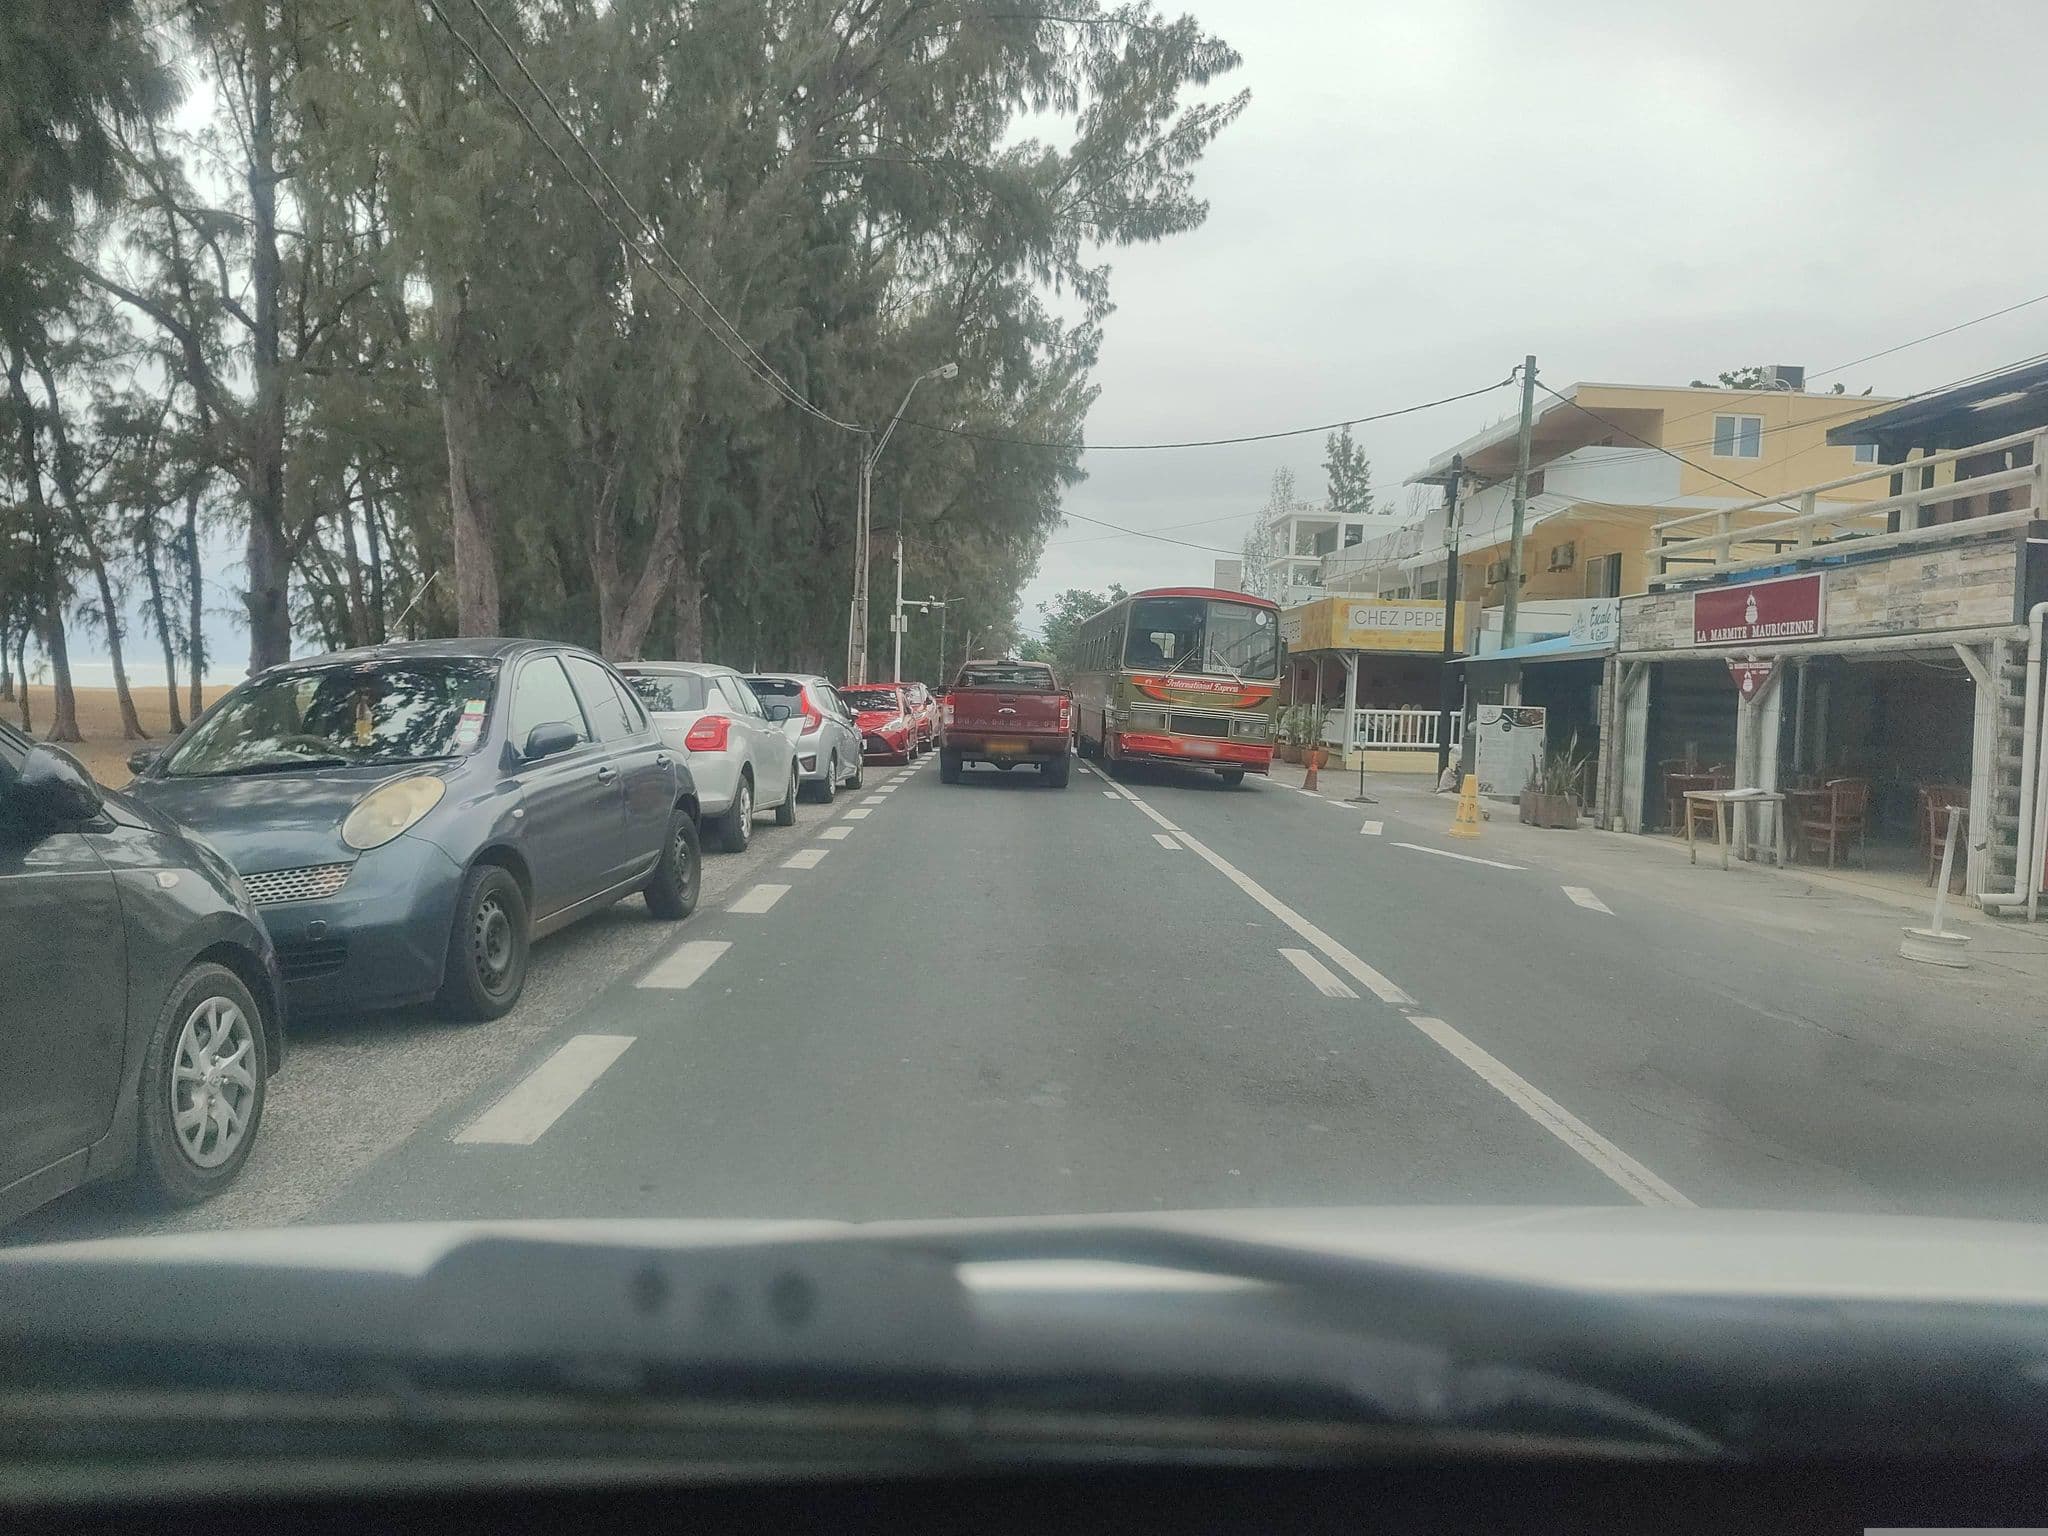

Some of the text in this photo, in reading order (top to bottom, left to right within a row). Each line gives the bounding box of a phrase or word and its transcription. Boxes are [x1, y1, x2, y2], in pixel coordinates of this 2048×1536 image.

[1354, 610, 1443, 627] CHEZ PEPE
[1697, 620, 1815, 642] LA MARMITE MAURICIENNE
[1165, 679, 1213, 691] International
[1214, 683, 1239, 694] Express
